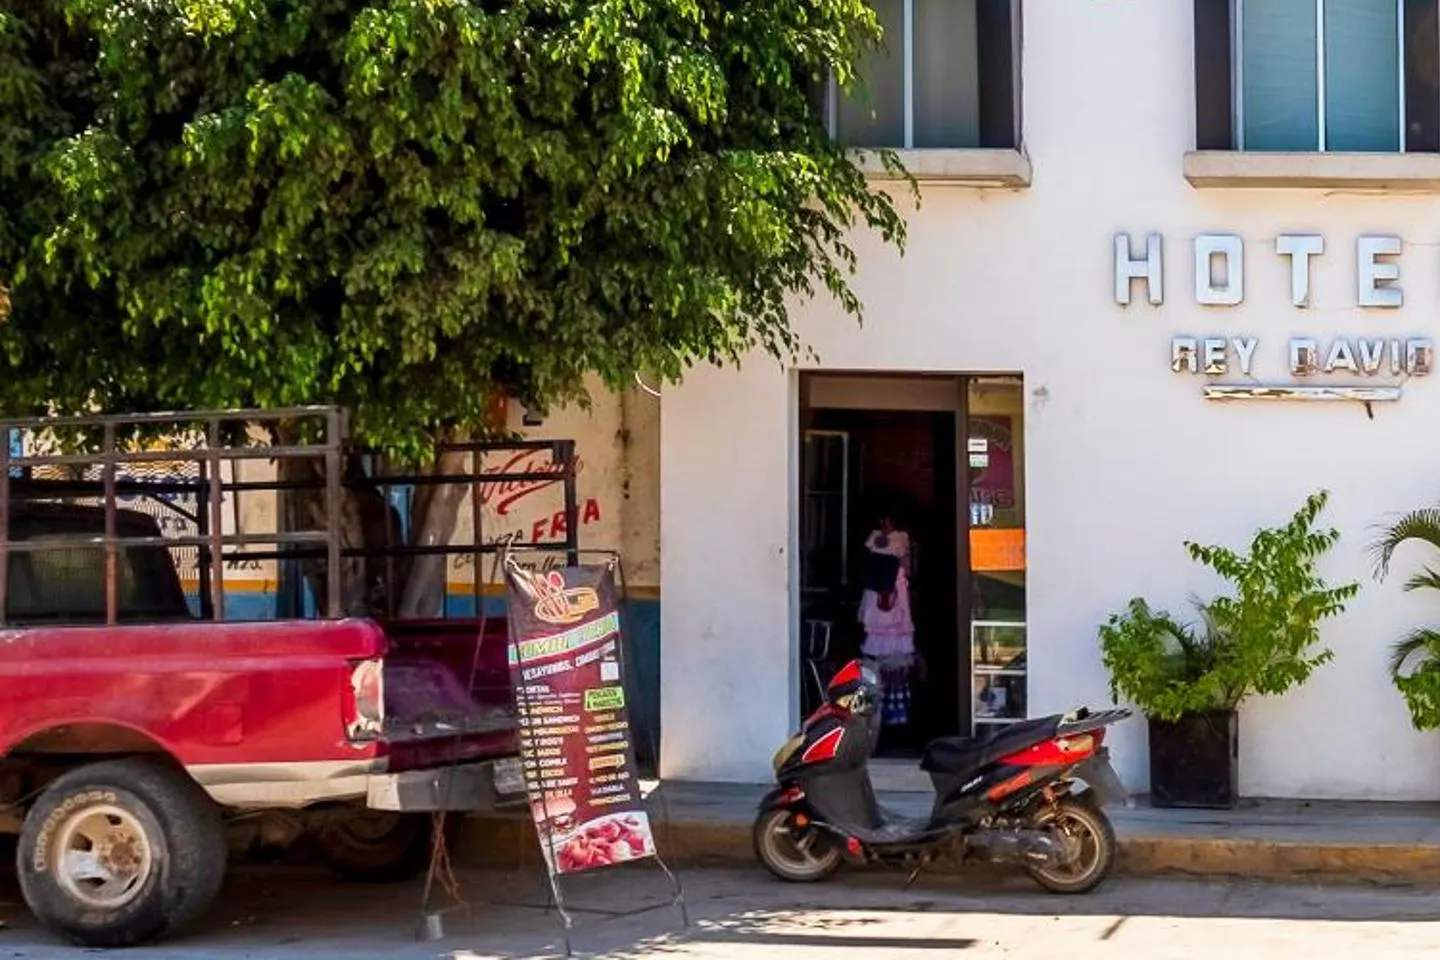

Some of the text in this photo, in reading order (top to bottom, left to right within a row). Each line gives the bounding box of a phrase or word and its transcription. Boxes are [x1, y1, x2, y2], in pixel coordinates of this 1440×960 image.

[1170, 335, 1434, 378] REY DAVID
[531, 498, 600, 543] FRA
